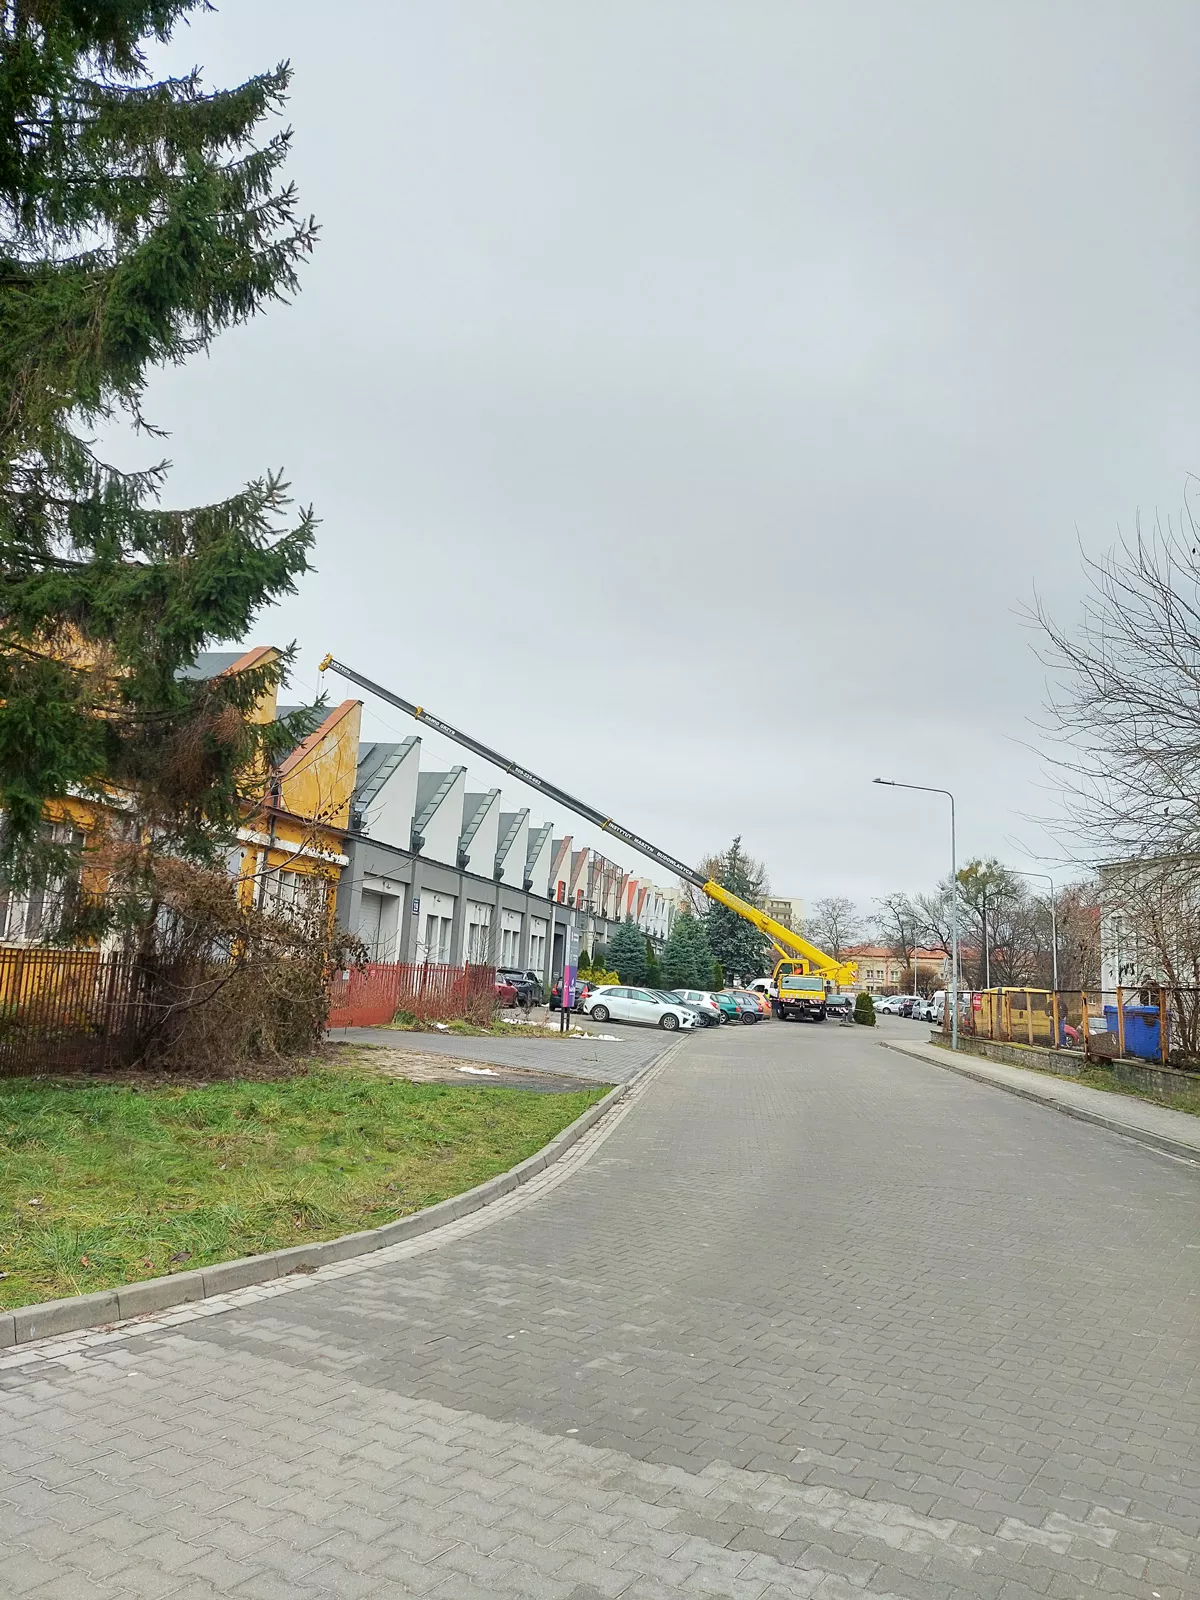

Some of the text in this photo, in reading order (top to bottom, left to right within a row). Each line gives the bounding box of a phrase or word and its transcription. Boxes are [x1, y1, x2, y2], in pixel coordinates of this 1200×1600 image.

[330, 660, 352, 676] VERTECH
[424, 715, 440, 727] DAWID
[608, 822, 694, 877] INSTYTUT MASZYN BUDOWLANYCH
